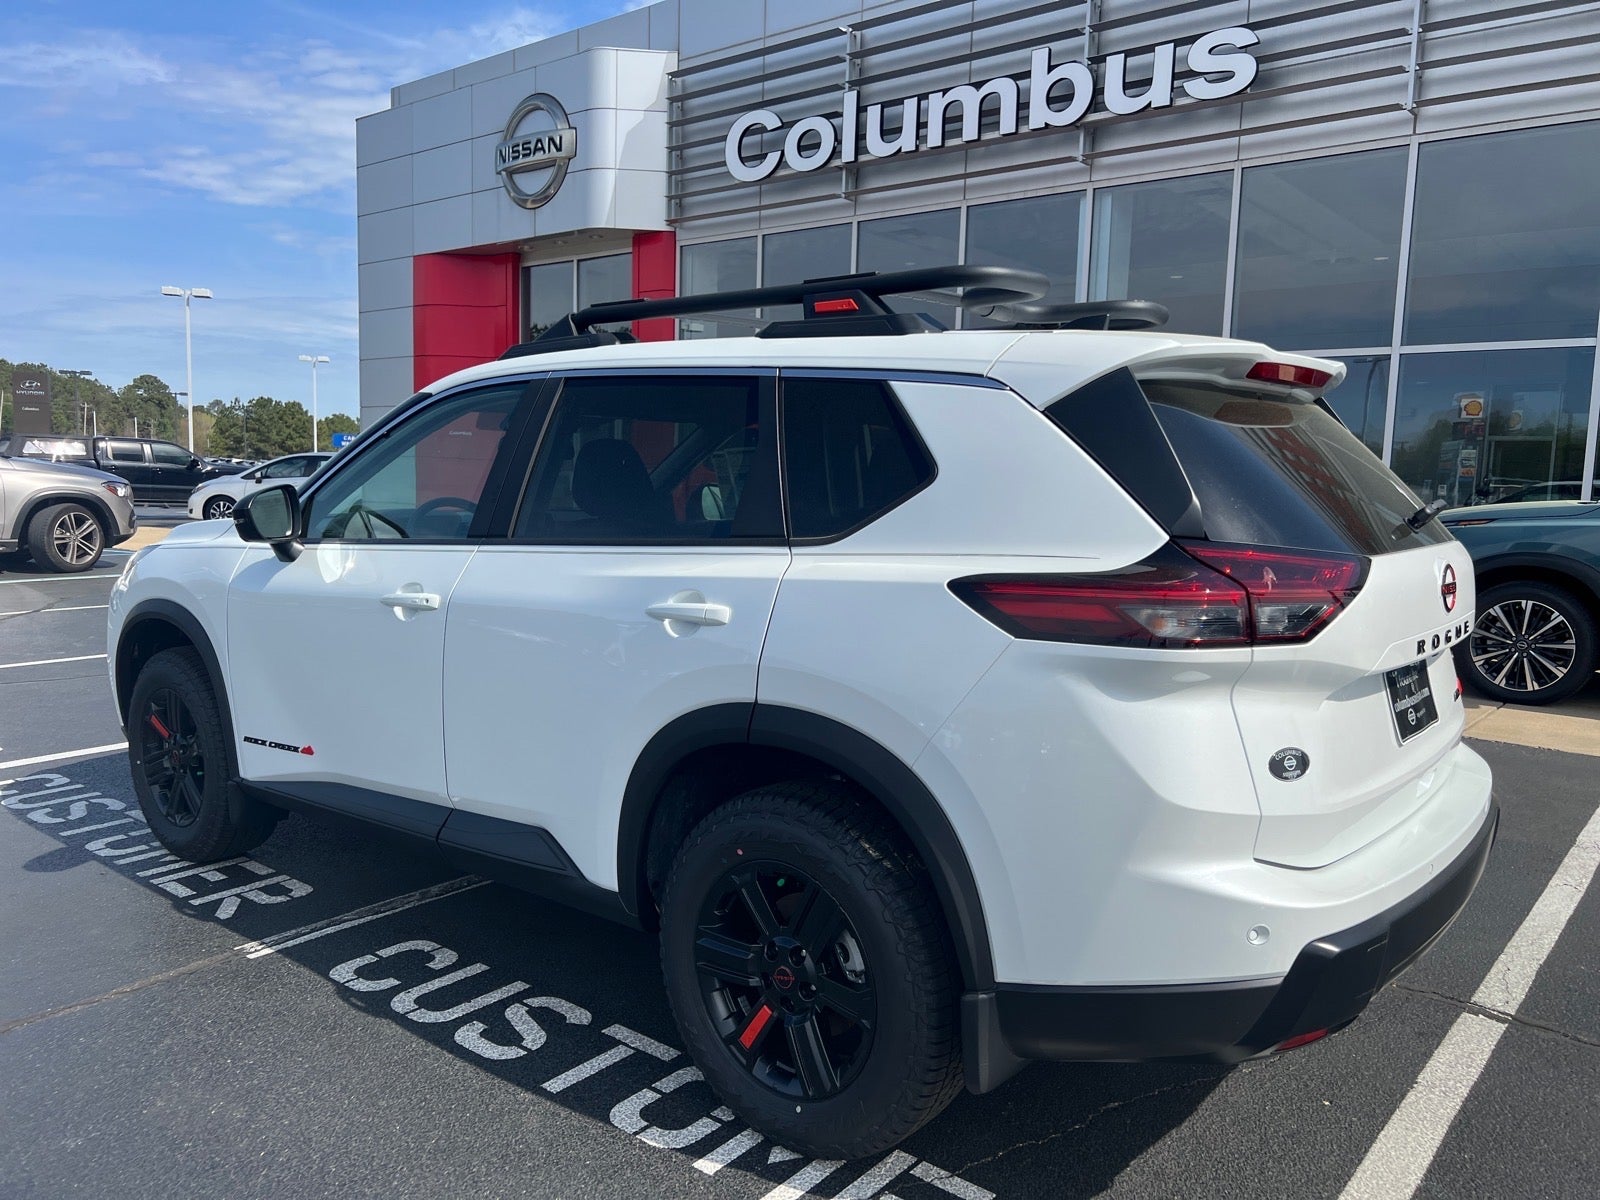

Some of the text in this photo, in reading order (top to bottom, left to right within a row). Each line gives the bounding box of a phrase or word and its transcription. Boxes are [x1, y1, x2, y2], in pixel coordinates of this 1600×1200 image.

[724, 26, 1261, 183] Columbus
[498, 135, 563, 165] NISSAN
[1416, 620, 1470, 656] ROGUE
[243, 735, 301, 754] ROCK CREEK
[1274, 749, 1303, 761] COLUMBUS
[0, 773, 314, 920] CUSTOMER
